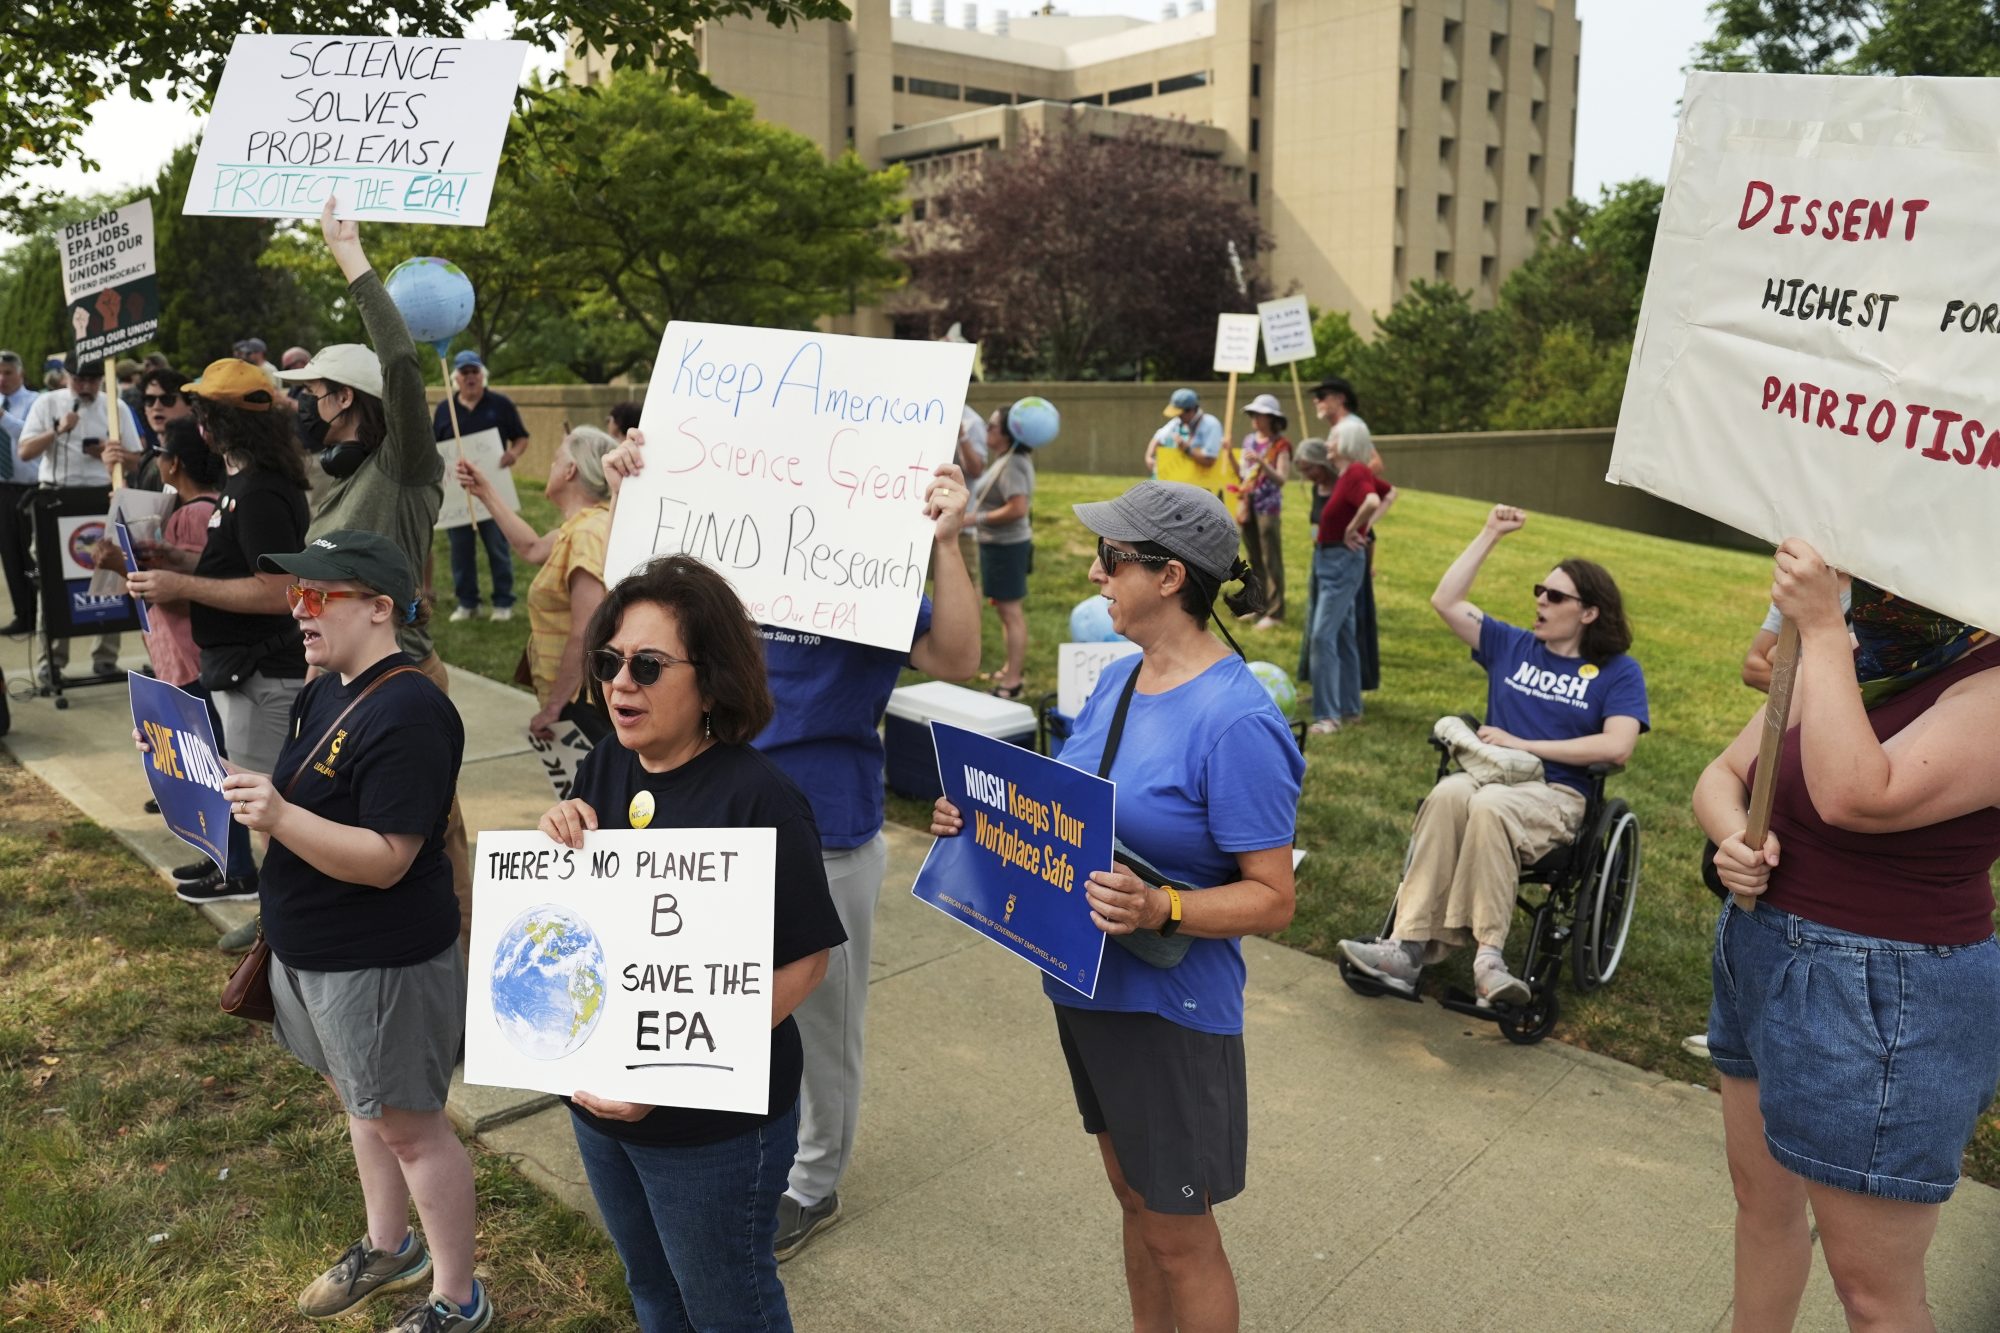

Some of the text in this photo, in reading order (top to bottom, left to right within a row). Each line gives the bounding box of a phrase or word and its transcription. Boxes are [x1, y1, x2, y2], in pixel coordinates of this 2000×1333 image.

[280, 41, 462, 80] SCIENCE
[288, 88, 427, 129] SOLVES
[247, 130, 455, 173] PROBLEMS!
[212, 168, 467, 212] PROTECT THE EPA!
[1737, 180, 1930, 242] DISSENT
[65, 210, 119, 240] DEFEND
[68, 222, 130, 256] EPA JOBS
[69, 234, 143, 270] DEFEND OUR
[69, 258, 116, 284] UNIONS
[70, 262, 147, 295] DEFEND DEMOCRACY
[1762, 277, 2000, 334] HIGHEST FOR
[76, 318, 158, 353] EFEND OUR UNION
[103, 332, 154, 357] DEMOCRACY
[672, 338, 945, 425] Keep American
[666, 416, 929, 509] Science Great
[652, 496, 923, 600] FUND Research
[771, 595, 804, 623] Our
[812, 602, 858, 637] EPA
[774, 631, 796, 643] Since
[798, 634, 821, 646] 1970
[1512, 661, 1590, 700] NIOSH
[143, 719, 184, 780] SAVE
[963, 764, 1085, 849] NIOSH Keeps Your
[489, 849, 739, 882] THERE'S NO PLANET
[975, 809, 1074, 893] Workplace Safe
[650, 893, 683, 937] B
[938, 892, 1068, 971] AMERICAN FEDERATION OF GOVERNMENT EMPLOYEES, AFL-CIO
[621, 961, 761, 996] SAVE THE
[636, 1010, 717, 1053] EPA
